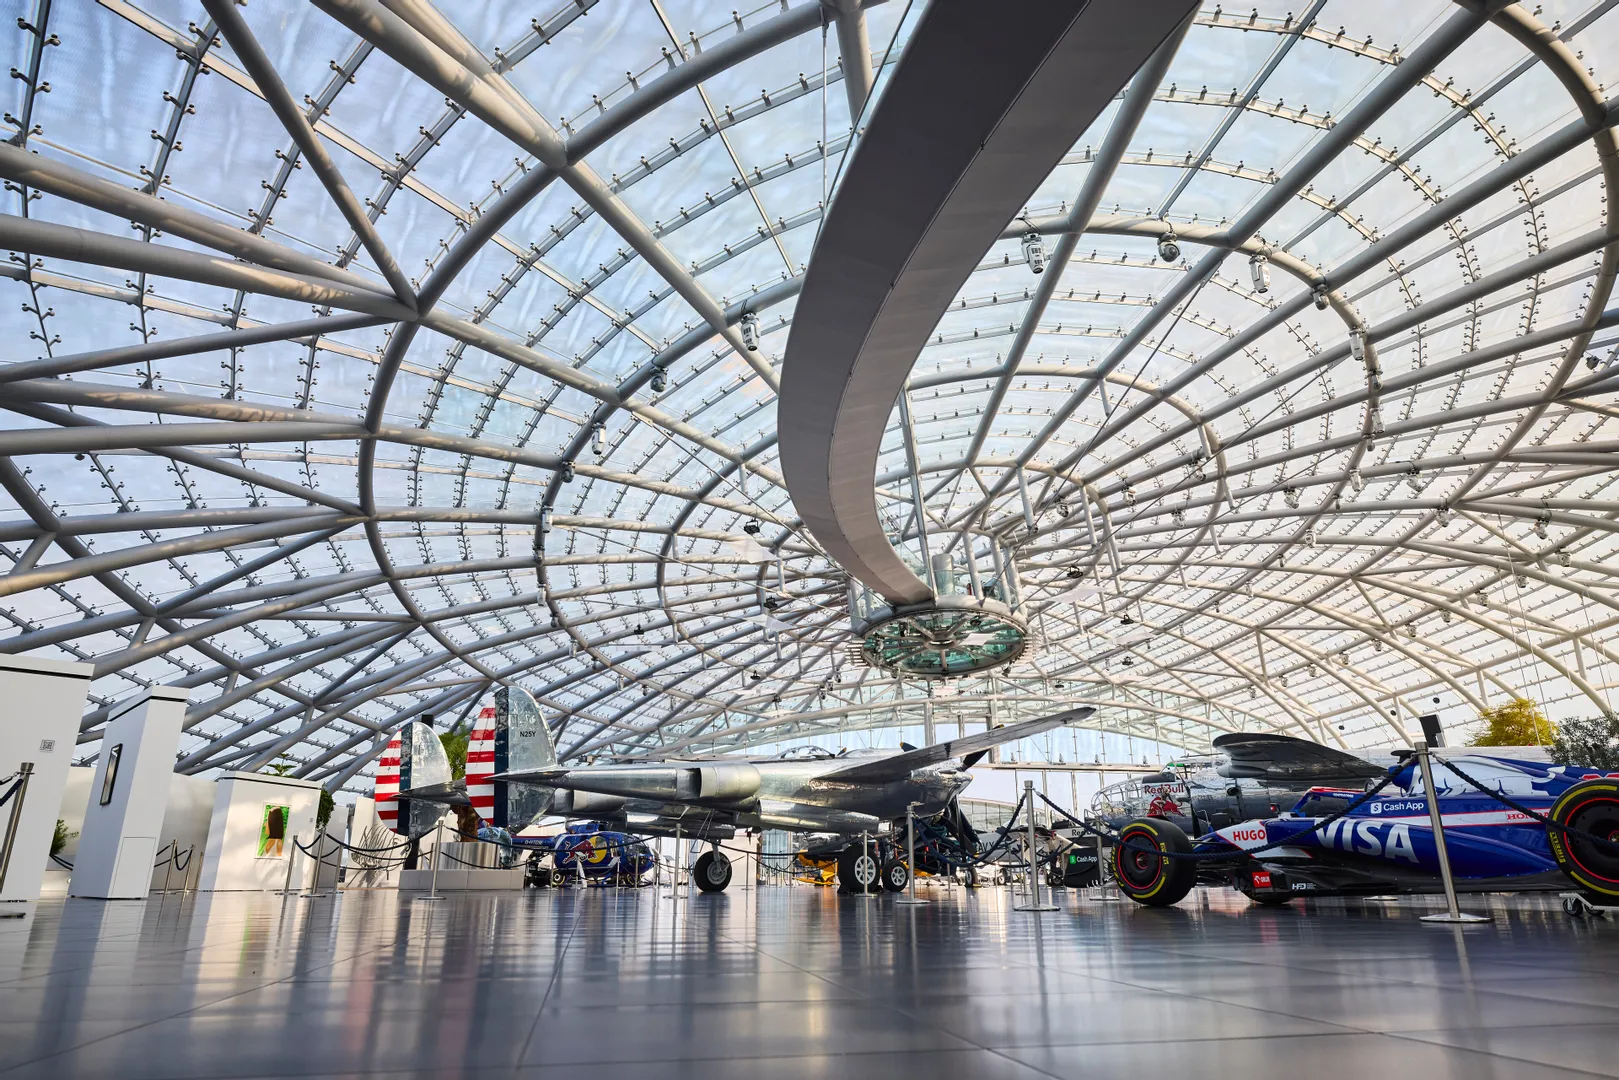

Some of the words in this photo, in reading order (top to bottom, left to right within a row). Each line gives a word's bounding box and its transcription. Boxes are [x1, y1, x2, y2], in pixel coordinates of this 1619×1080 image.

[1383, 803, 1405, 811] Cash
[1406, 802, 1424, 811] App
[1232, 829, 1266, 842] HUGO
[1315, 818, 1420, 864] VISA
[1088, 855, 1098, 863] App
